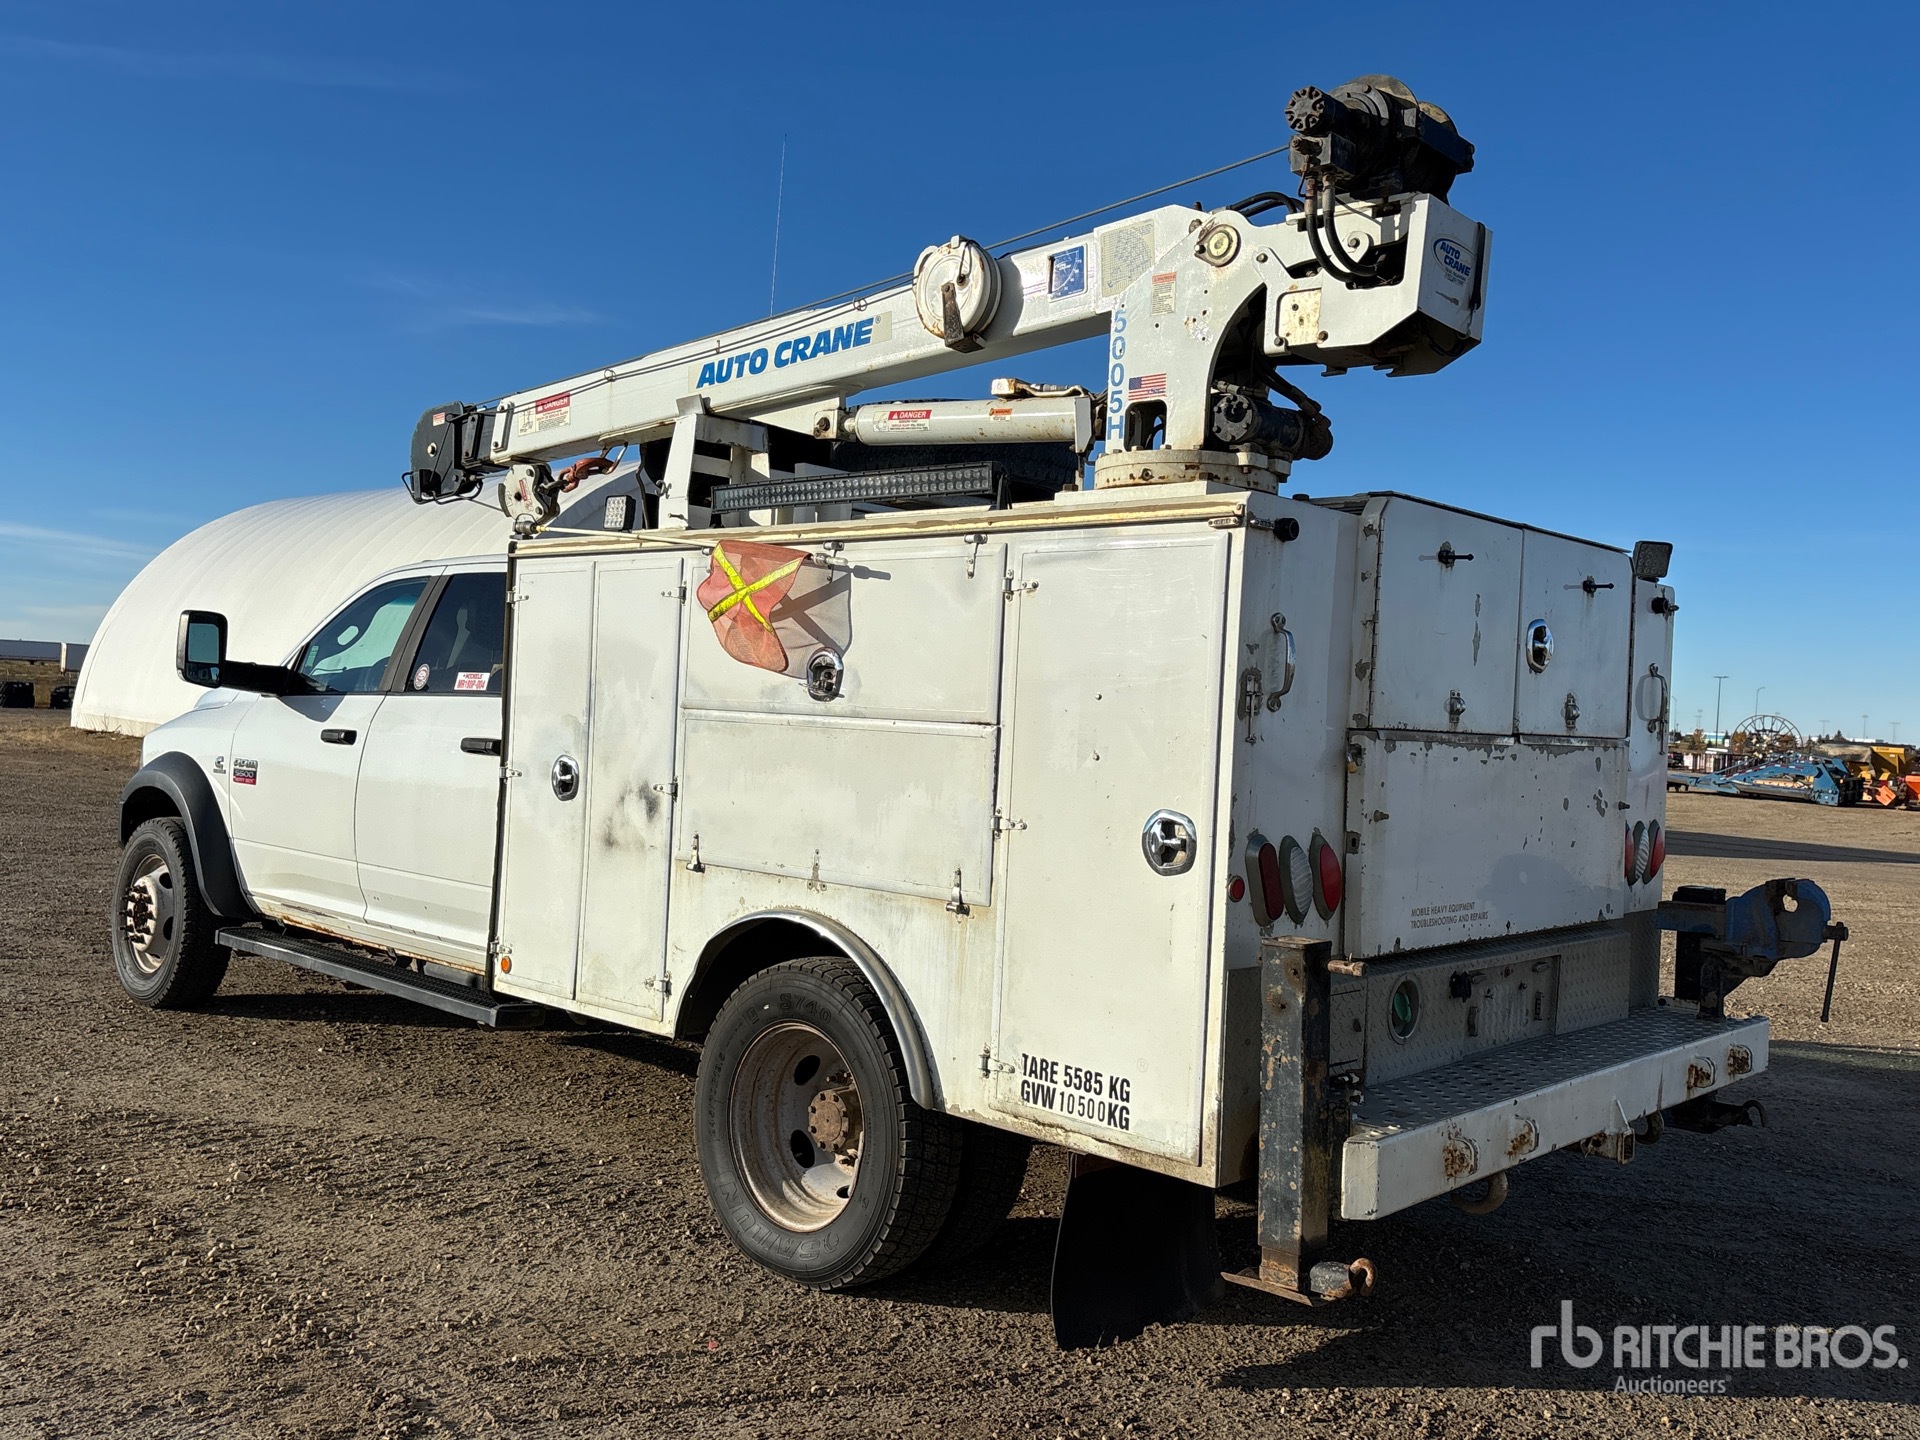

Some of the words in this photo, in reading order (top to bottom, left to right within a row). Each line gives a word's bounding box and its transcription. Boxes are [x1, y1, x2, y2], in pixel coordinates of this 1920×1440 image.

[1440, 241, 1460, 260] AUTO
[1444, 254, 1471, 276] CRANE
[696, 347, 769, 389] AUTO
[1107, 309, 1127, 440] 5005H
[899, 410, 927, 419] DANGER
[234, 769, 254, 778] 5500
[1410, 906, 1430, 917] MOBILE
[1431, 904, 1448, 915] HEAVY
[1448, 901, 1475, 913] EQUIPMENT
[1411, 915, 1457, 929] TROUBLESHOOTING
[1458, 913, 1470, 922] AND
[1470, 911, 1488, 921] REPAIRS
[1021, 1052, 1059, 1085] TARE
[1063, 1064, 1103, 1096] 5585
[1108, 1075, 1131, 1103] KG
[1020, 1079, 1057, 1110] GVW
